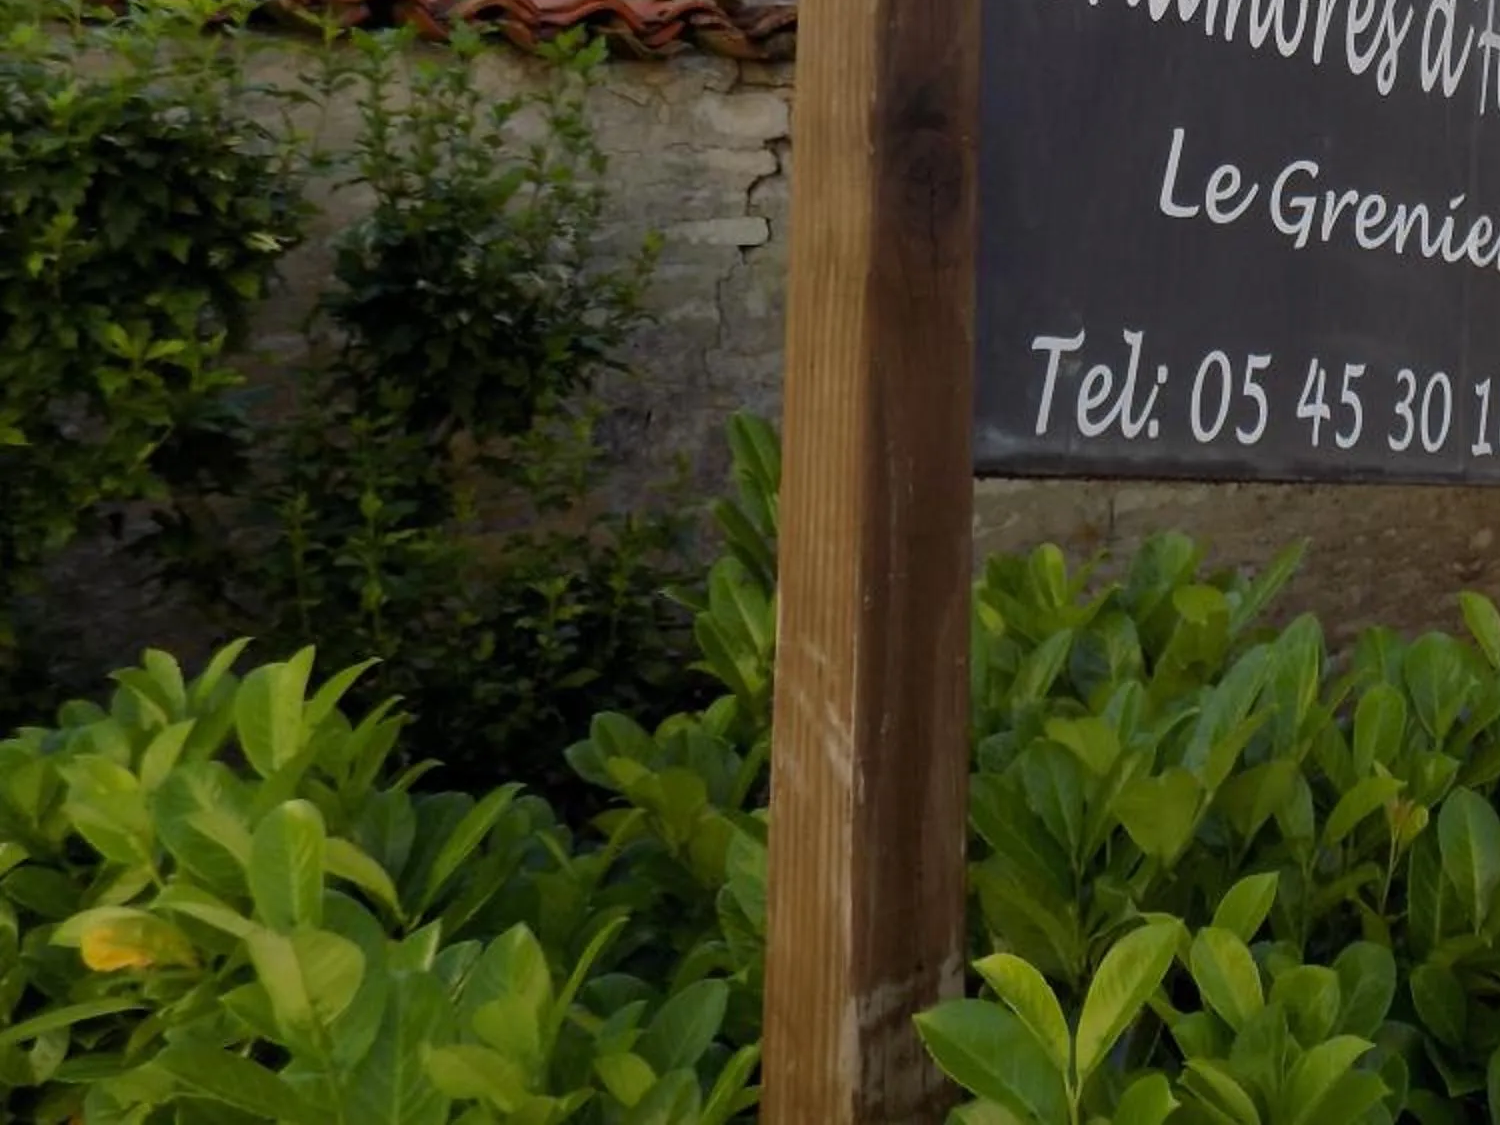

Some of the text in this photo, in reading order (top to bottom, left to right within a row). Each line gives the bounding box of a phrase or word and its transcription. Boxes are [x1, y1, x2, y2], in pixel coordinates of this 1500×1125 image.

[1159, 127, 1259, 224] Le
[1030, 329, 1168, 439] Tel:
[1190, 350, 1272, 445] 05
[1296, 358, 1367, 449] 45
[1388, 369, 1453, 453] 30
